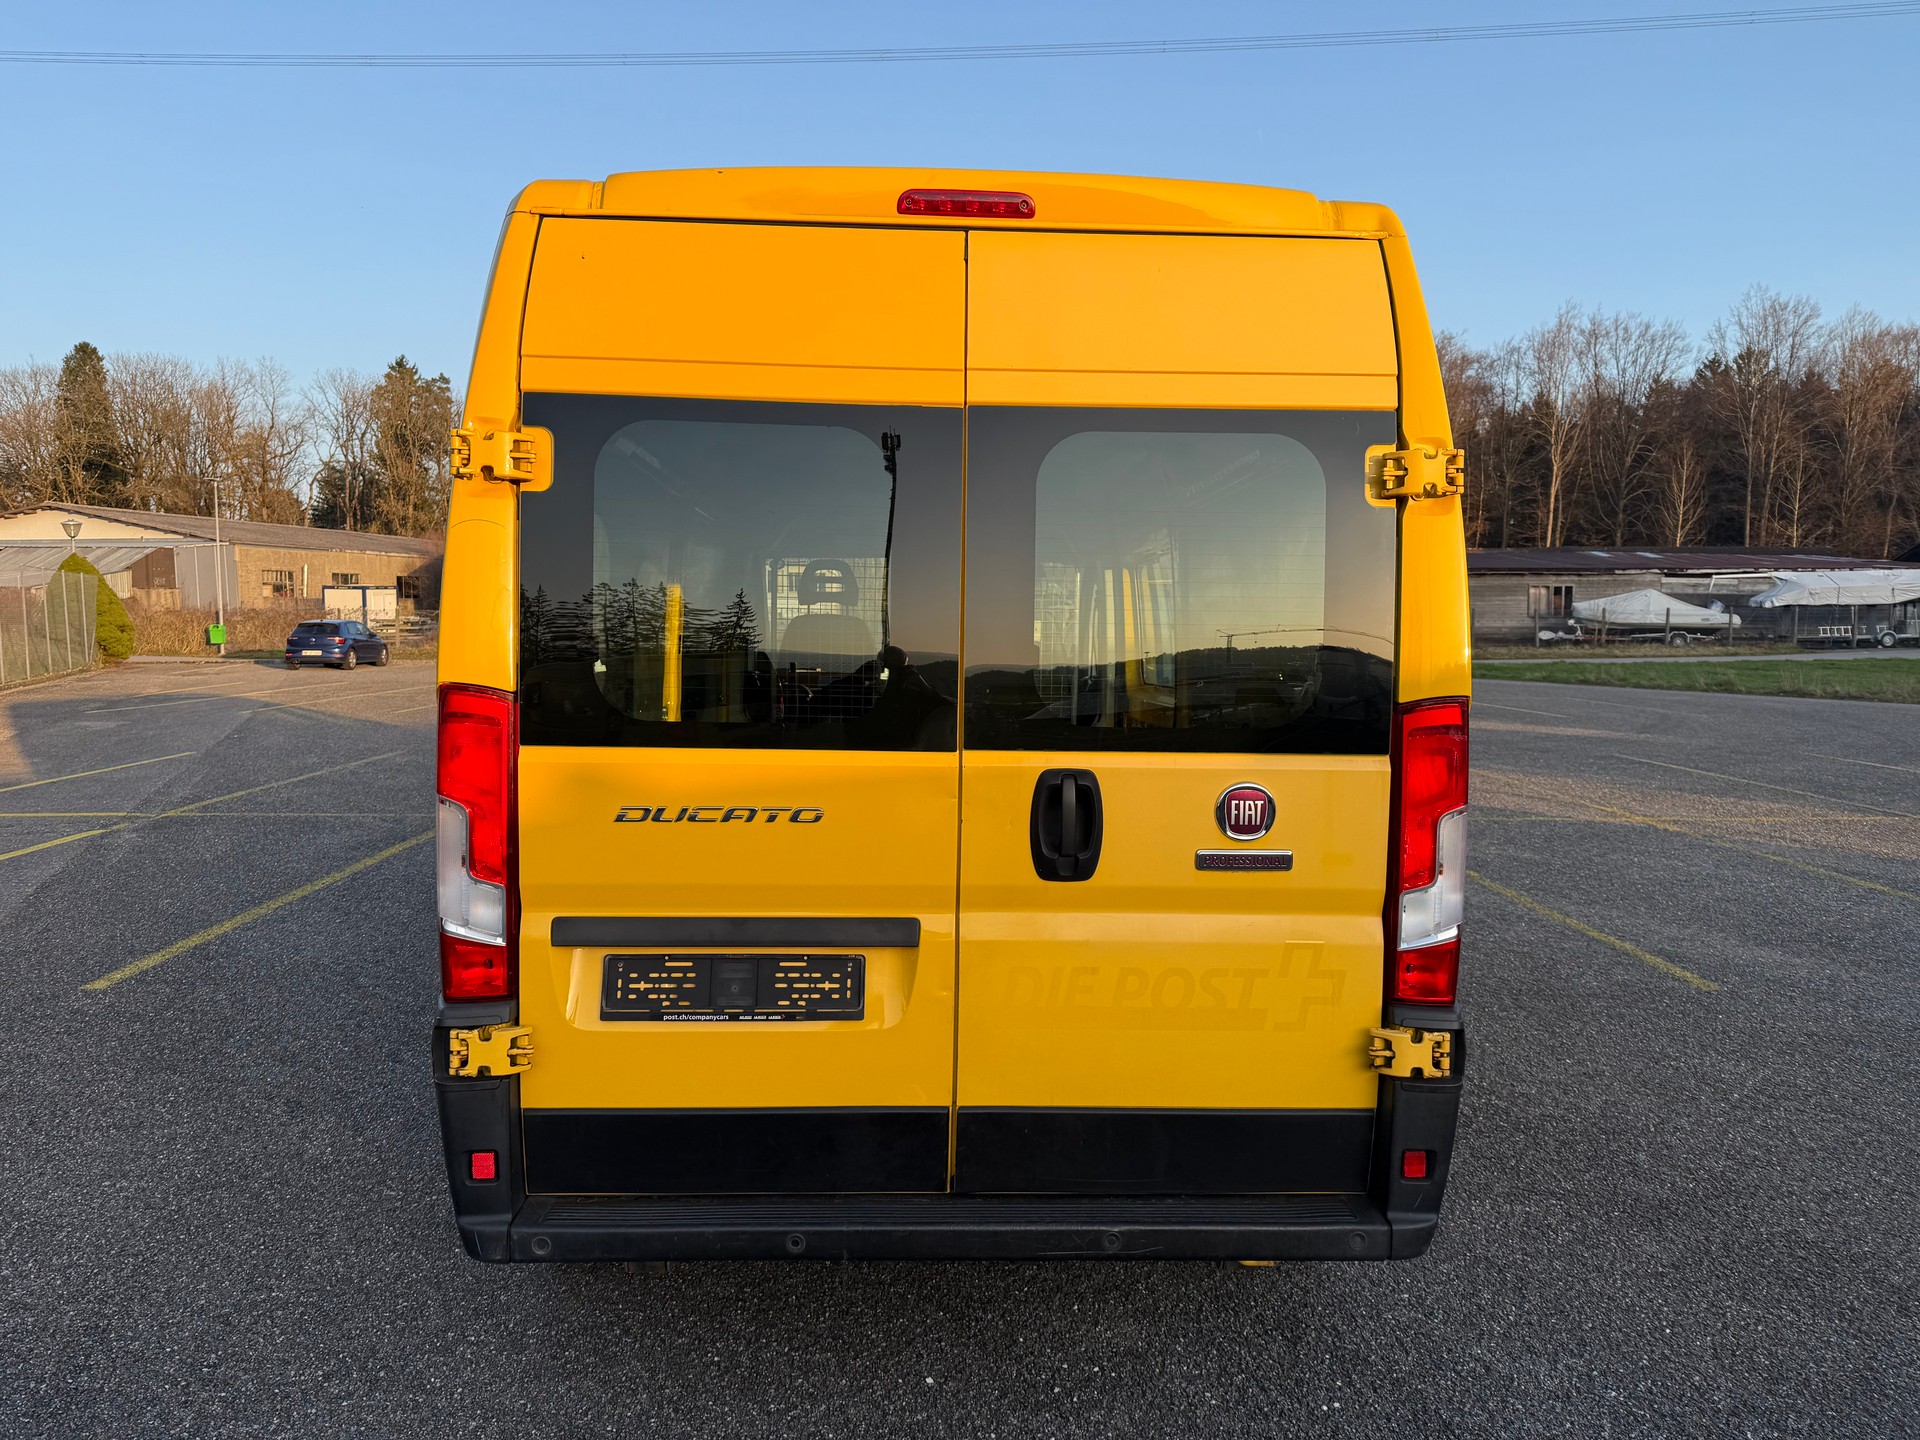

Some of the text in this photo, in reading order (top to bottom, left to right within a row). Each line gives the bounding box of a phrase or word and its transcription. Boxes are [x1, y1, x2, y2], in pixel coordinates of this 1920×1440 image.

[613, 806, 825, 823] DUCATO
[1231, 800, 1264, 825] FIAT
[1204, 856, 1287, 867] PROFESSIONAL
[1003, 966, 1270, 1009] DIE POST
